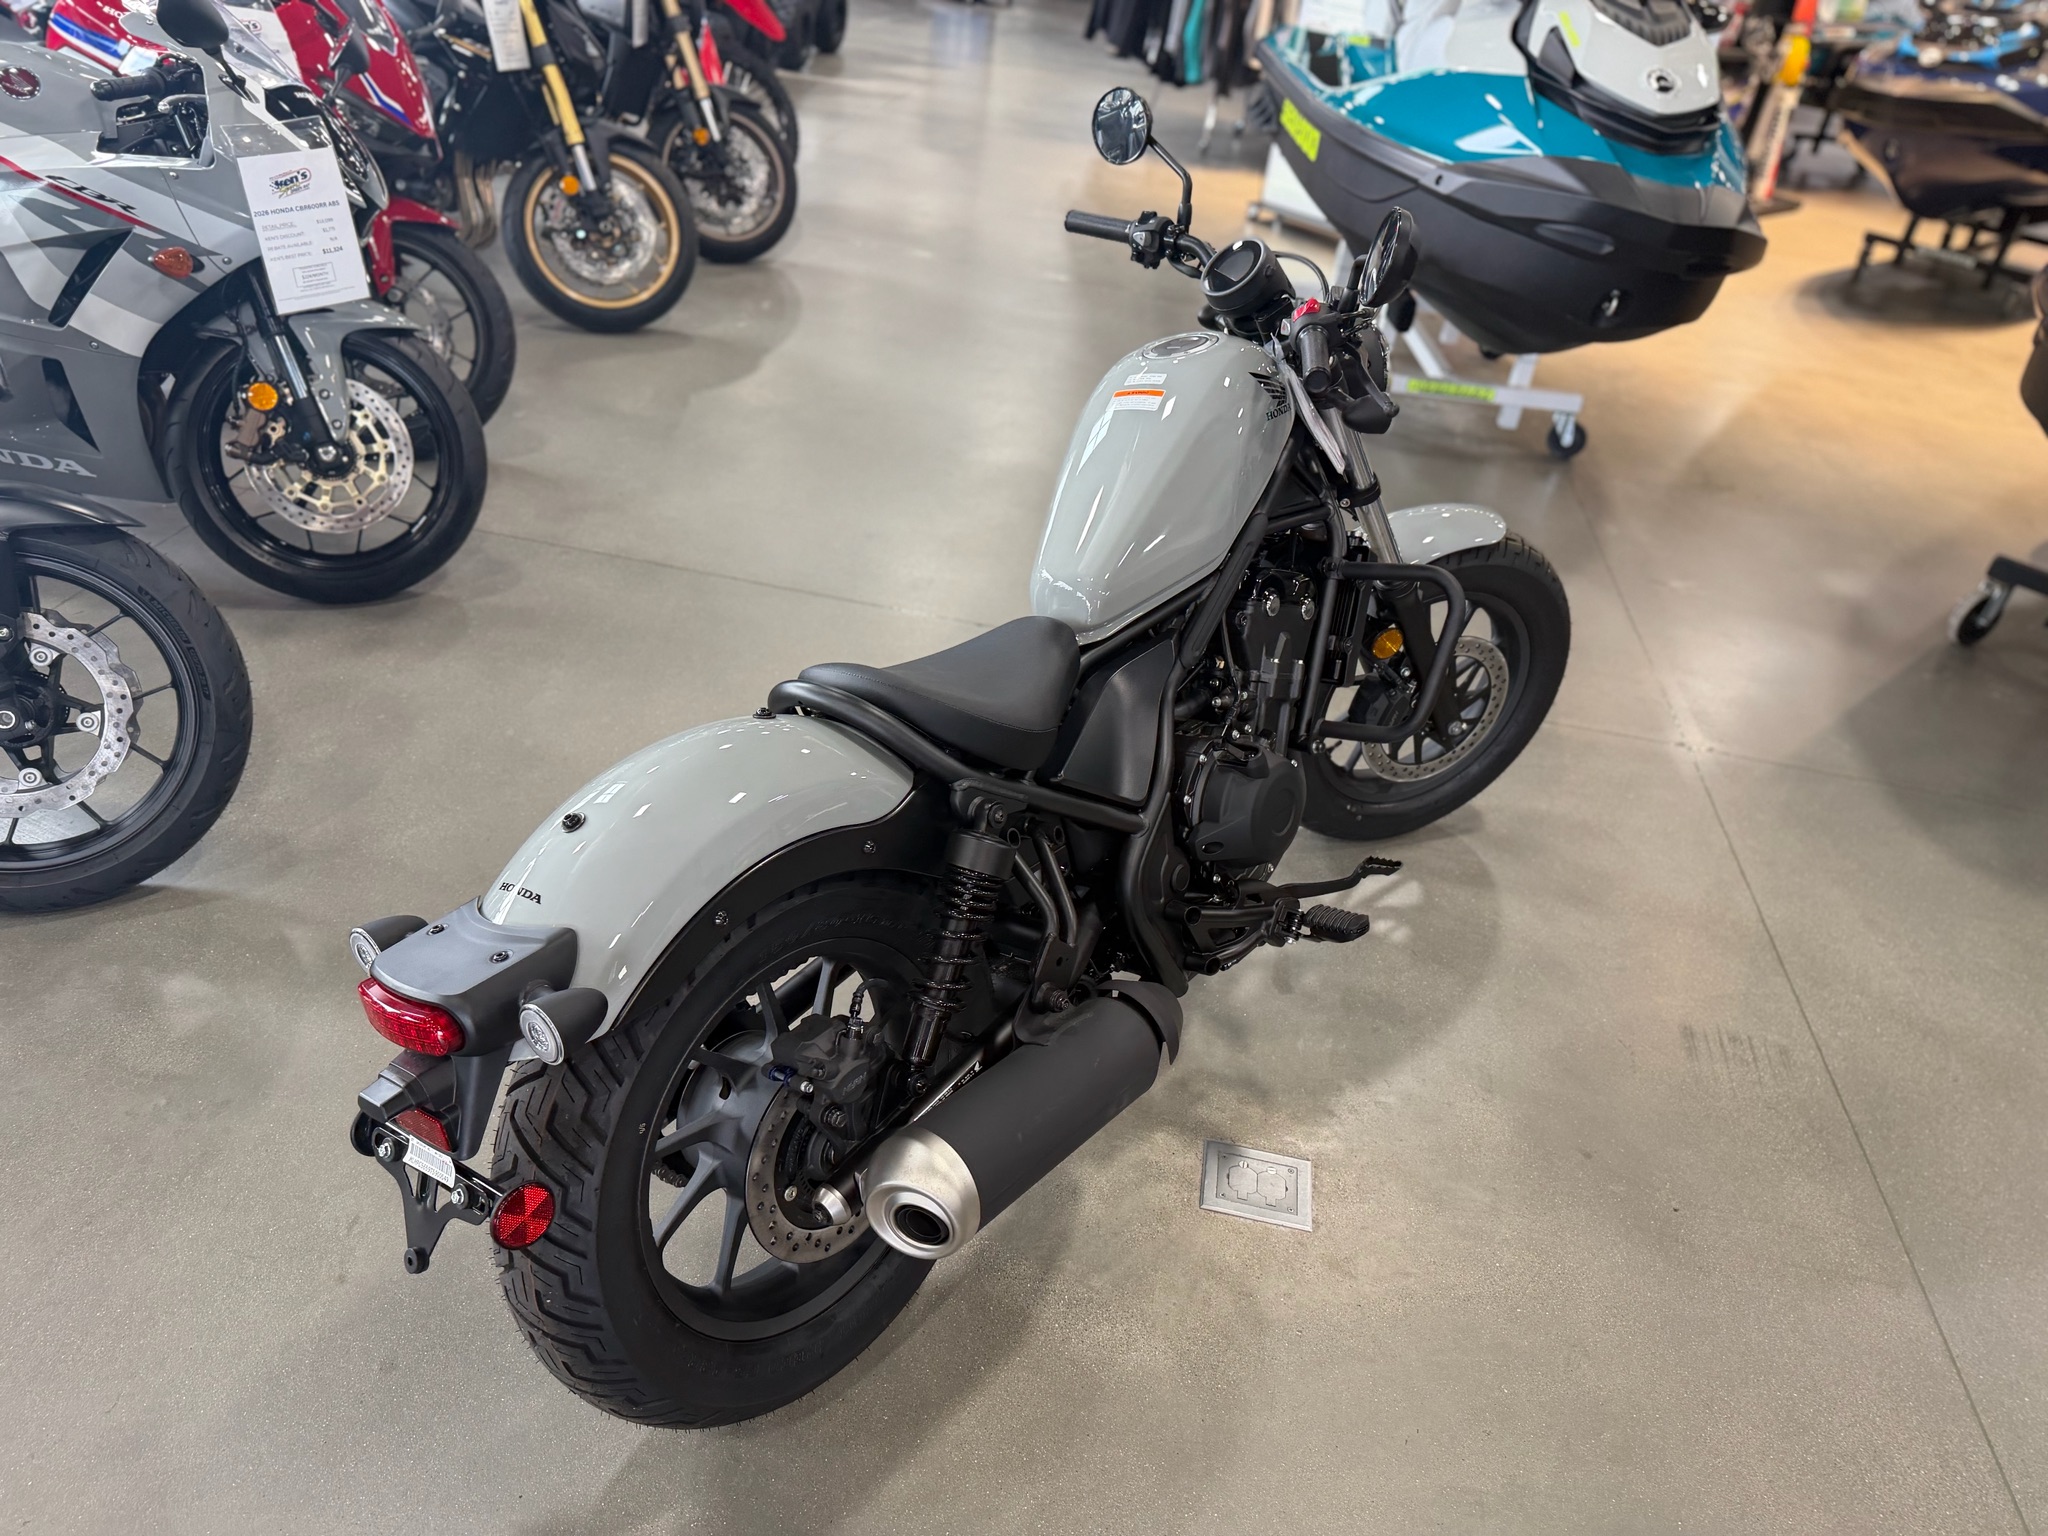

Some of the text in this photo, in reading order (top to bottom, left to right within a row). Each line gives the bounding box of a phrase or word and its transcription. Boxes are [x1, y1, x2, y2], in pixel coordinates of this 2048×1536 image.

[45, 174, 140, 217] CBR
[254, 209, 269, 217] 2026
[270, 206, 294, 215] HONDA
[295, 202, 328, 212] CBR600RR
[322, 246, 344, 254] $11,324
[499, 882, 542, 904] HONDA
